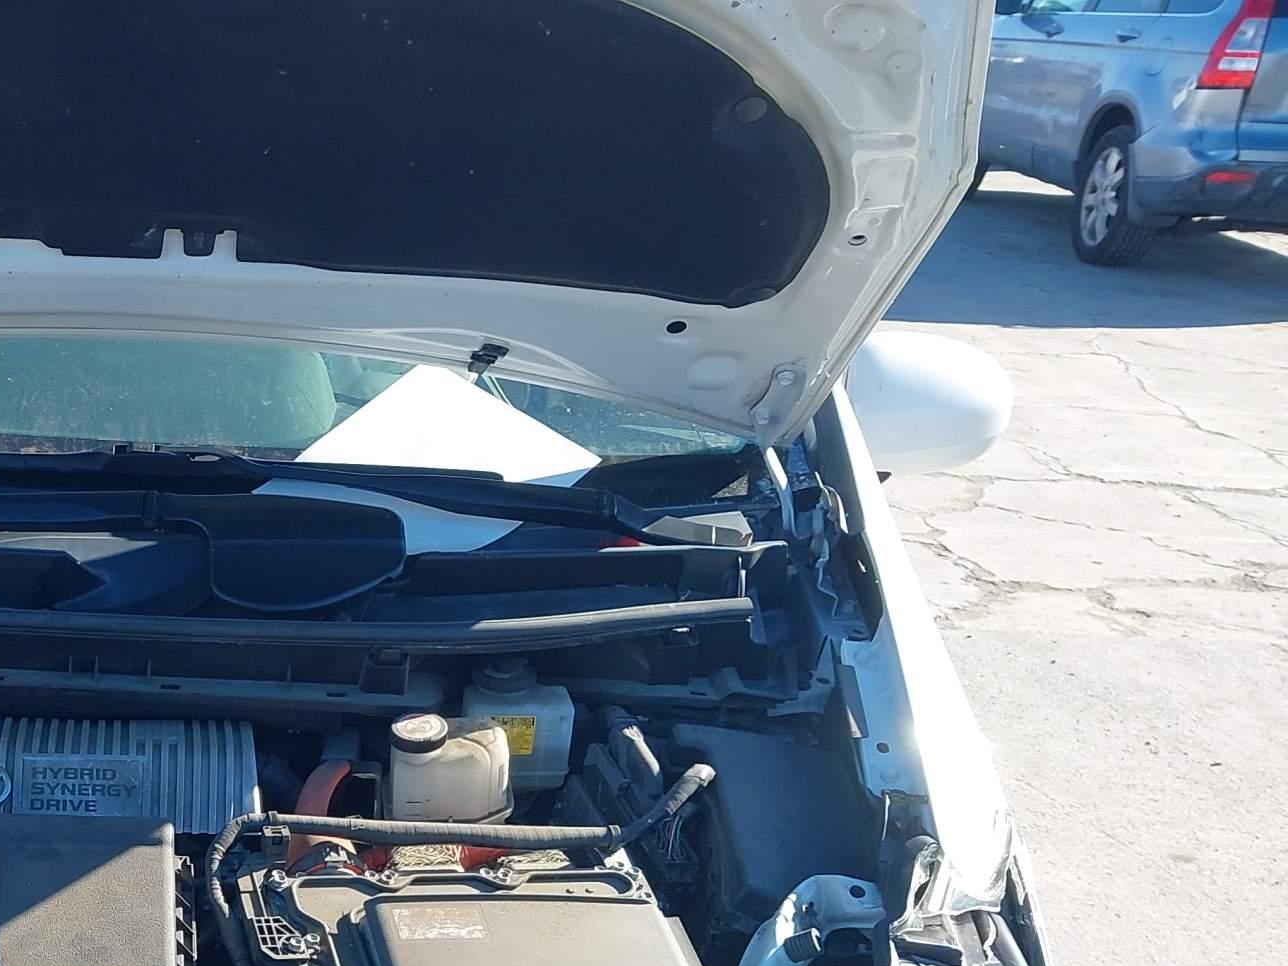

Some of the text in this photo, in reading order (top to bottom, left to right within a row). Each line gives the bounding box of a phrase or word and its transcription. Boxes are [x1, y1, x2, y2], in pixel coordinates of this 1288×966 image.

[31, 766, 117, 781] HYBRID
[30, 782, 137, 797] SYNERGY
[30, 798, 97, 813] DRIVE
